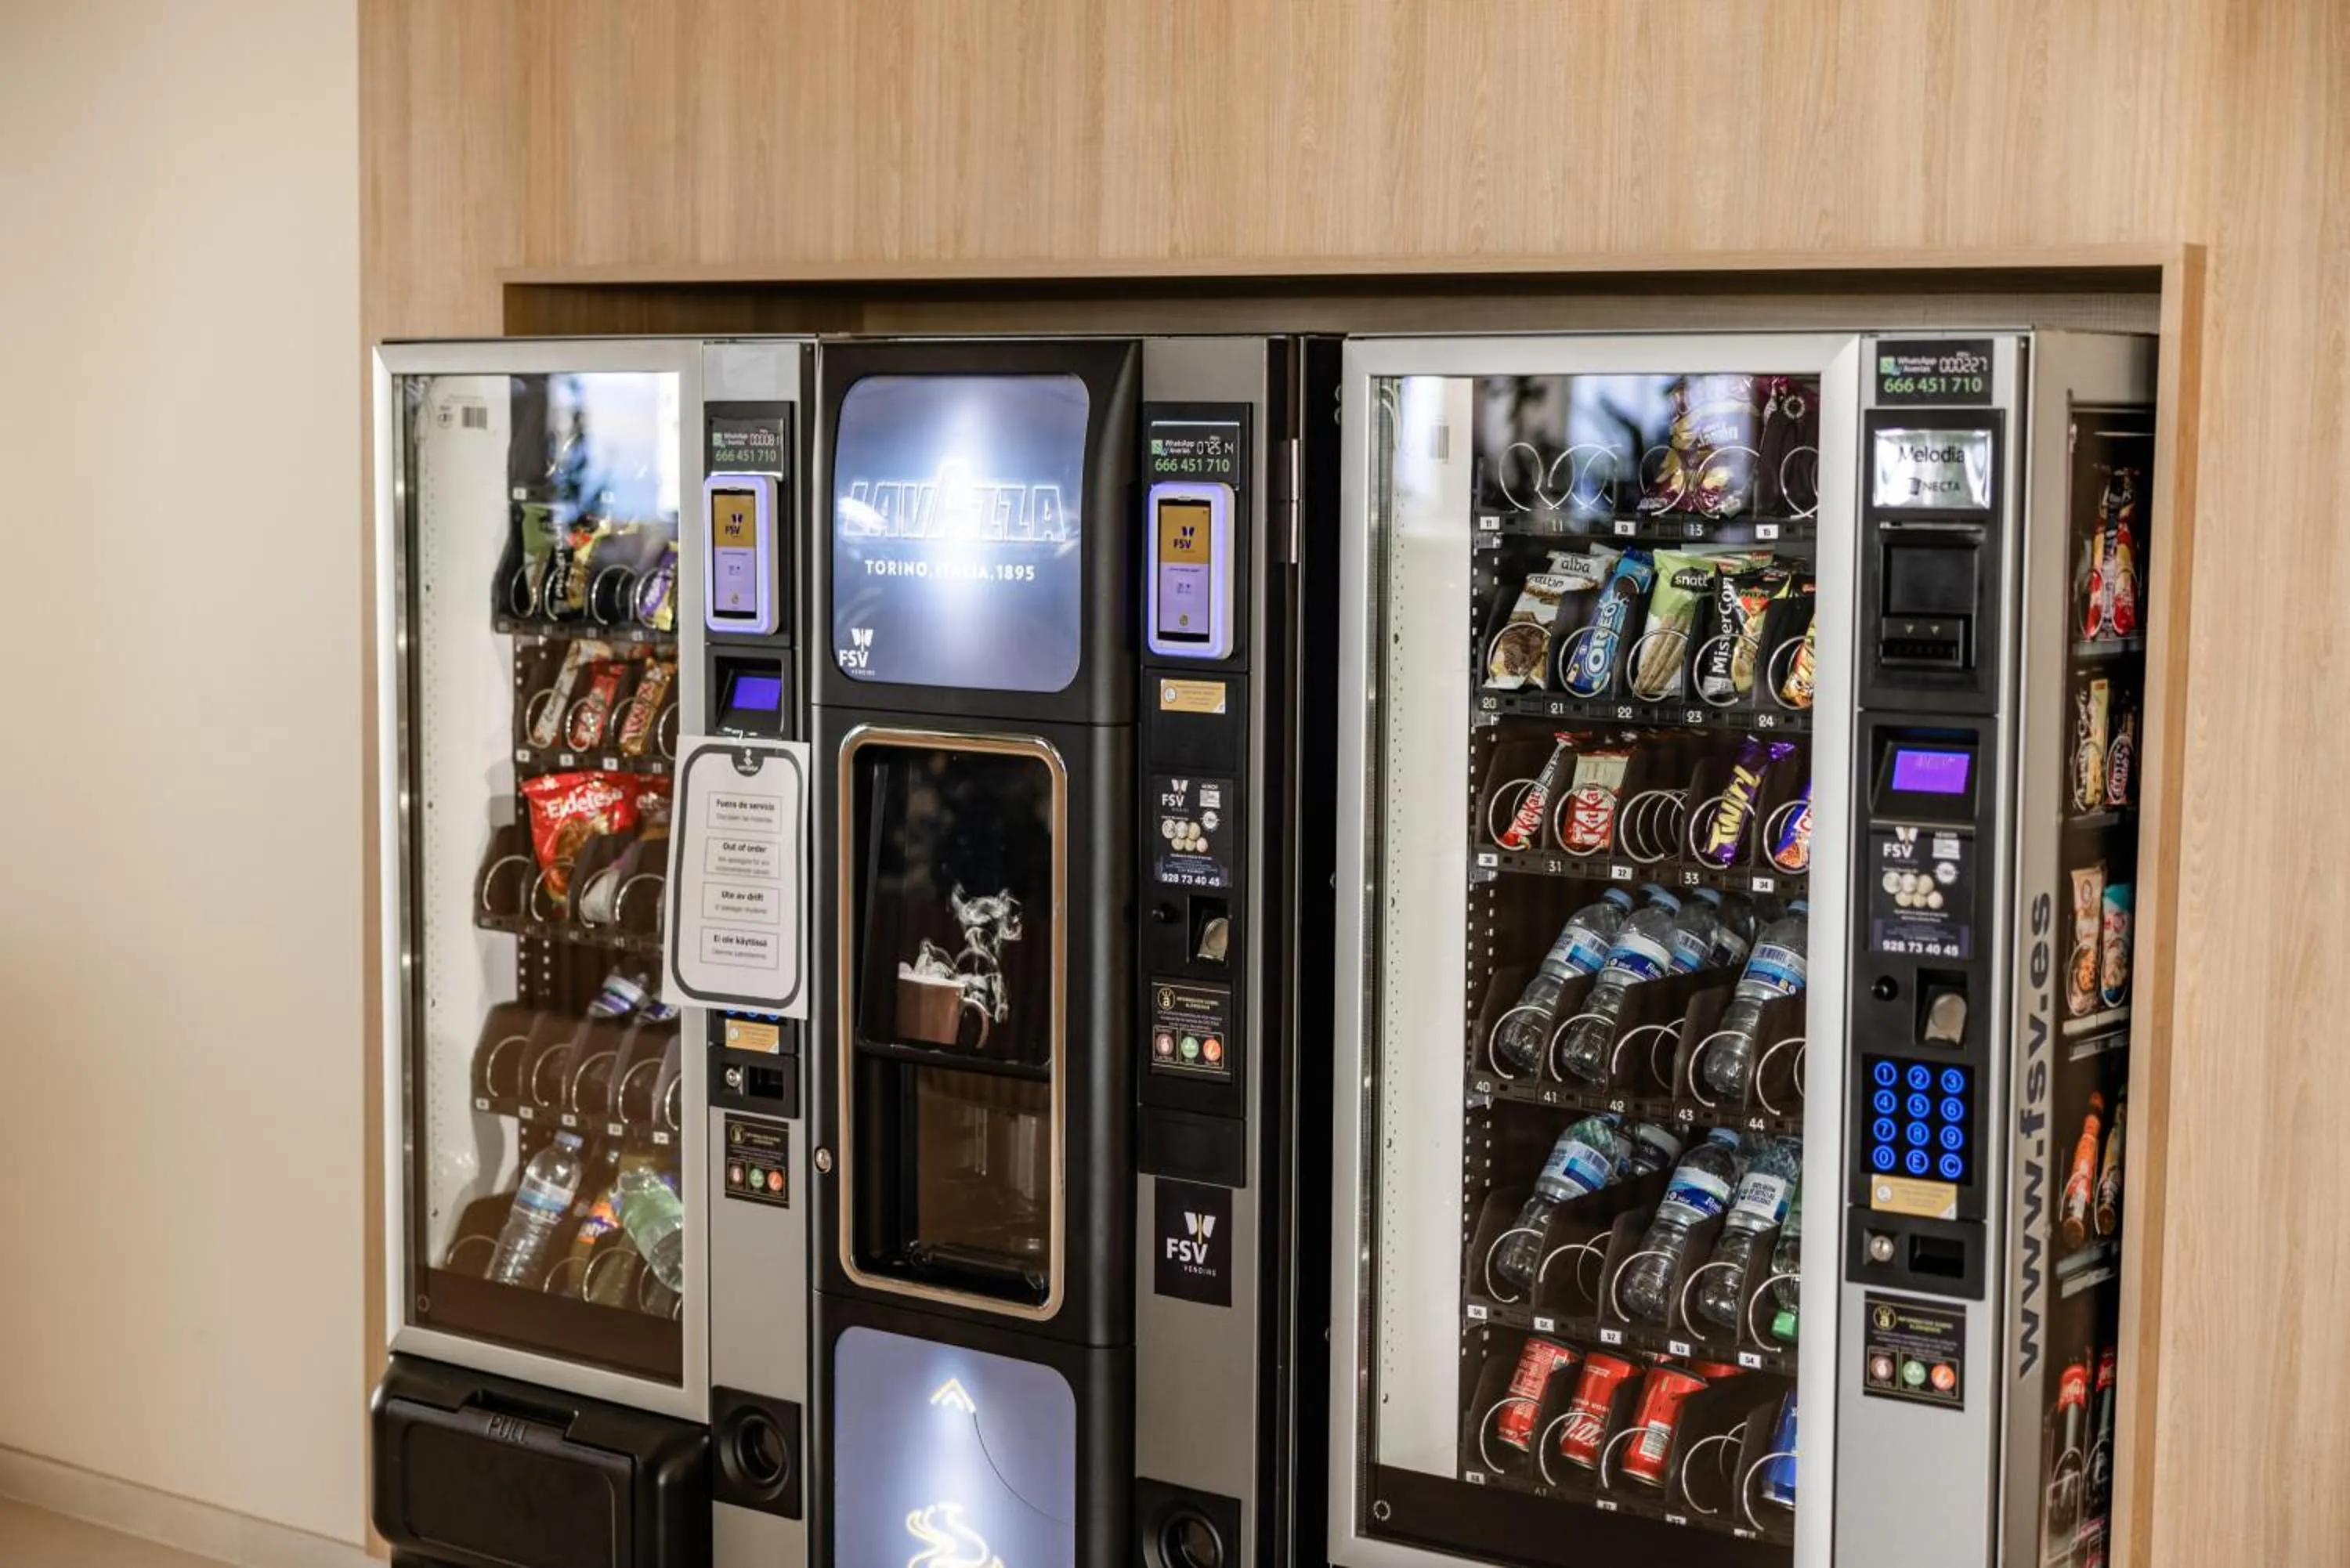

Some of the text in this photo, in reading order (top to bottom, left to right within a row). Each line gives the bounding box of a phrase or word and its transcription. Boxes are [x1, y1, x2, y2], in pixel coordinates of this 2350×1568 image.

[1884, 378, 1983, 392] 666 451 710
[715, 449, 776, 462] 666 451 710
[1899, 446, 1965, 463] Melodia
[1155, 458, 1230, 472] 666 451 710
[725, 526, 740, 535] FSV
[1689, 523, 1703, 537] 13
[1173, 539, 1191, 549] FSV
[996, 565, 1035, 581] 1895
[1587, 602, 1619, 674] OREO
[839, 649, 869, 668] FSV
[1482, 697, 1497, 710] 20
[1550, 703, 1564, 714] 21
[1618, 707, 1632, 719] 22
[1687, 710, 1702, 722] 23
[1759, 715, 1774, 728] 24
[1162, 793, 1184, 807] FSV
[723, 843, 736, 851] Out
[1882, 843, 1913, 858] FSV
[1549, 860, 1562, 873] 31
[1181, 875, 1193, 883] 73
[1195, 876, 1206, 885] 40
[1684, 873, 1699, 884] 33
[1882, 940, 1959, 956] 928 73 40 45
[1476, 1081, 1491, 1093] 40
[1543, 1092, 1557, 1103] 41
[1609, 1100, 1626, 1112] 42
[1678, 1109, 1694, 1121] 43
[1748, 1119, 1765, 1131] 44
[2019, 891, 2052, 1378] www.fsv.es
[1166, 1237, 1208, 1265] FSV
[1184, 1265, 1217, 1277] VENDING
